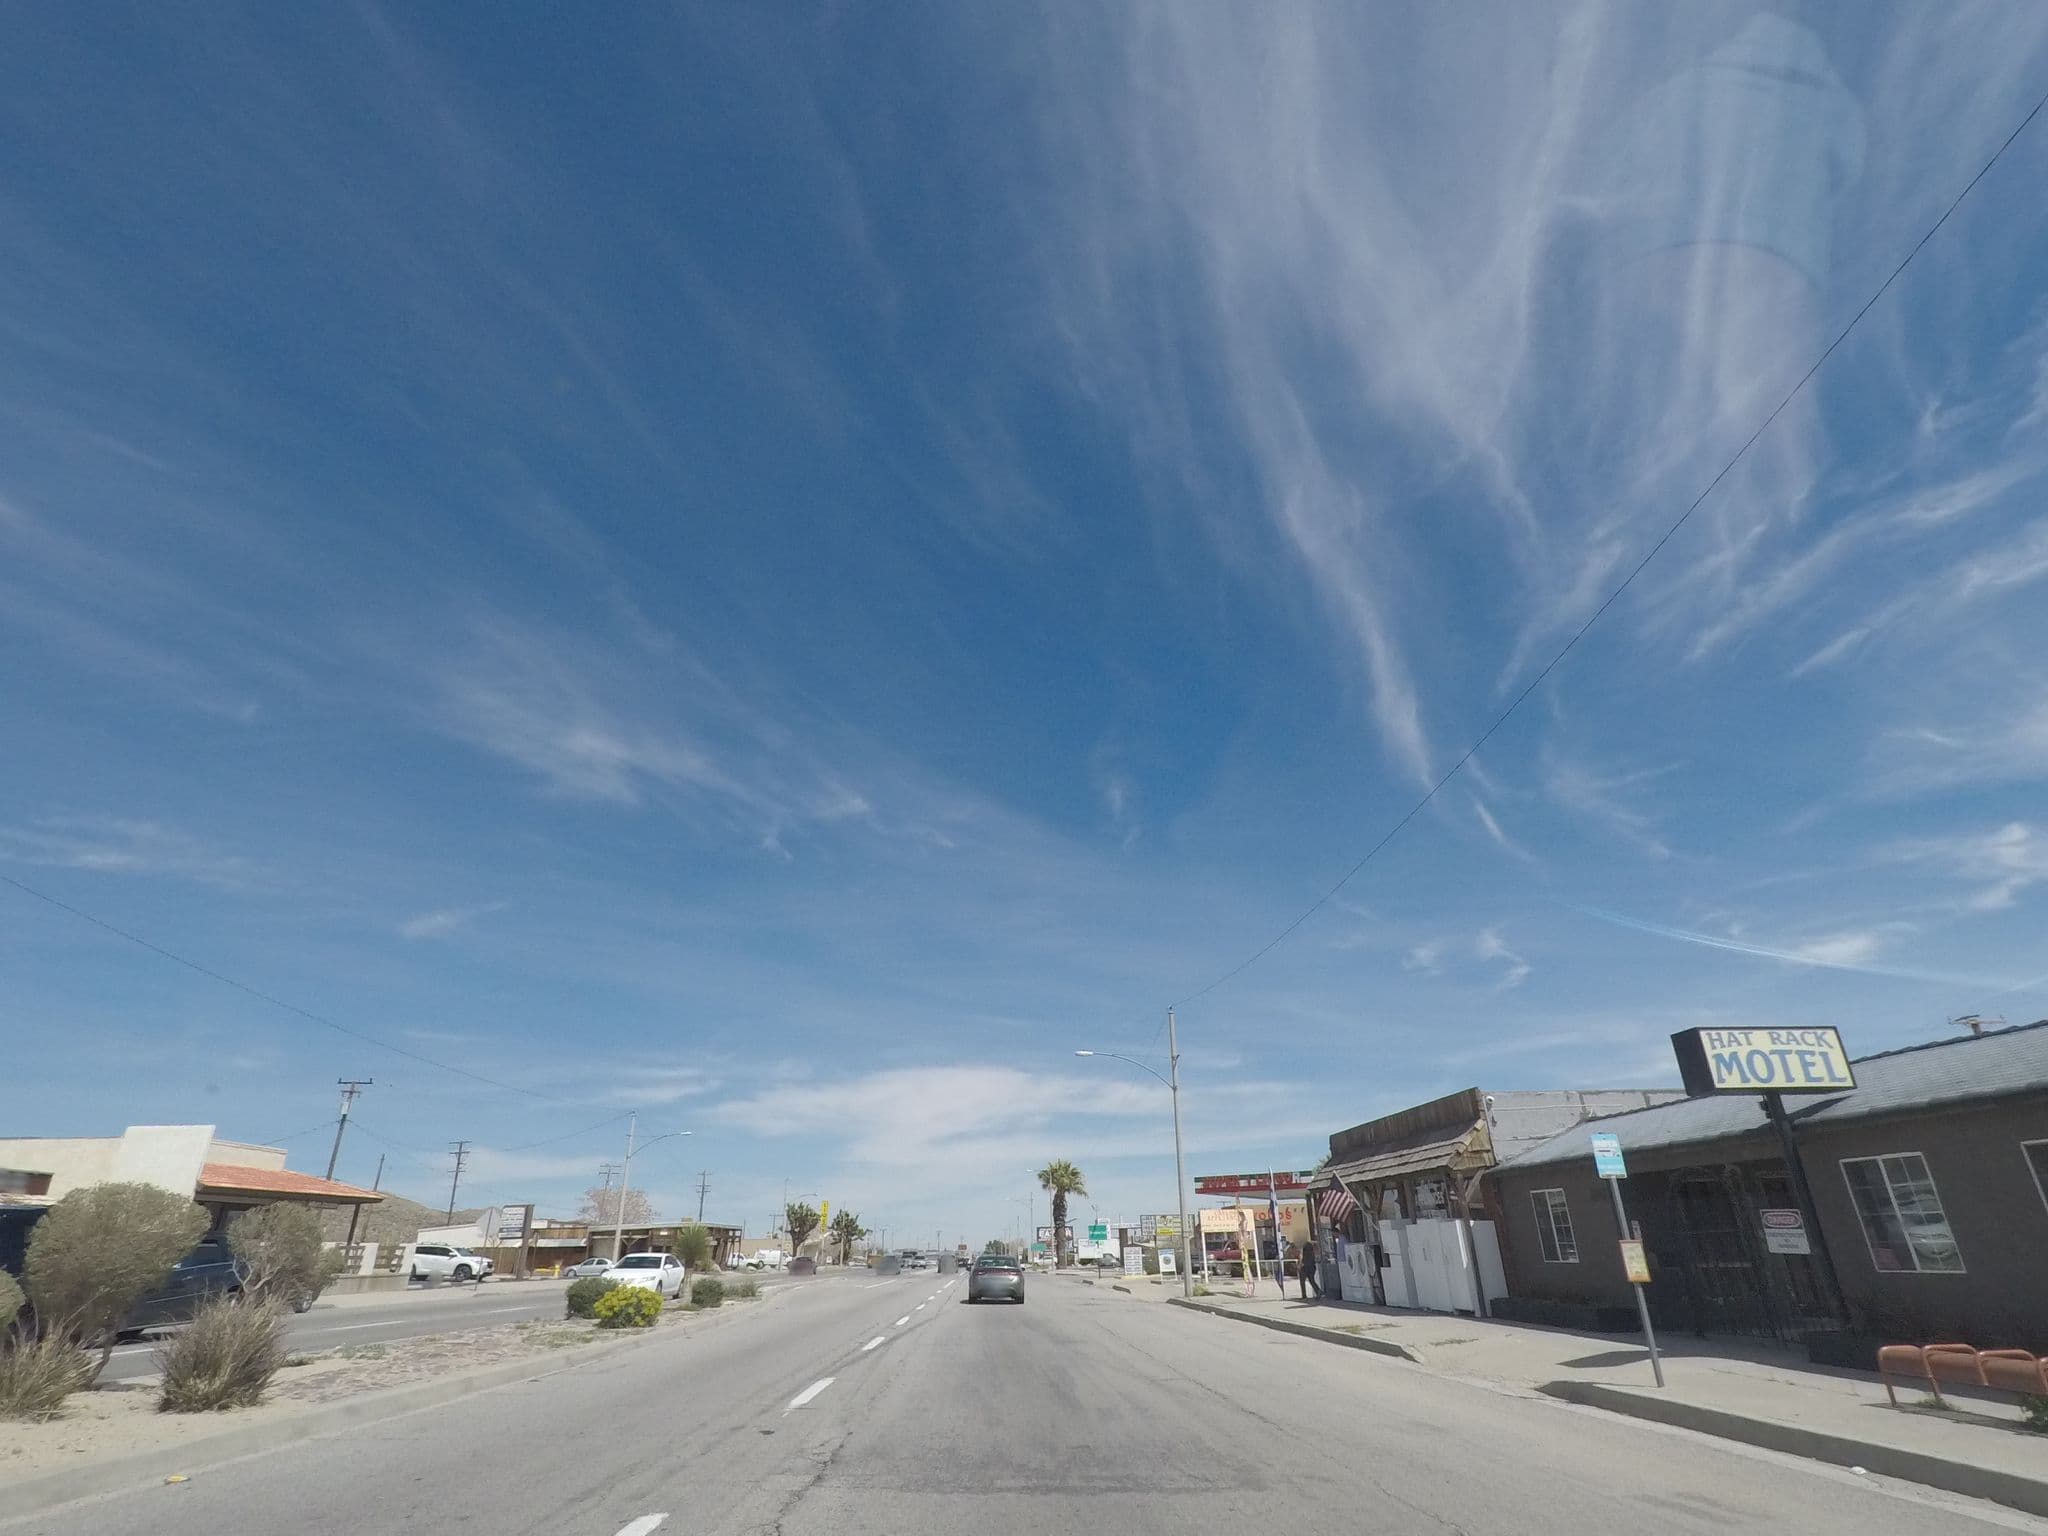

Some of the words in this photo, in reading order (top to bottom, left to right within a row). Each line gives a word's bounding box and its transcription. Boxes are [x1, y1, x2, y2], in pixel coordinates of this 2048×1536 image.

[1706, 1031, 1753, 1048] HAT
[1769, 1031, 1833, 1048] RACK
[1712, 1049, 1847, 1083] MOTEL
